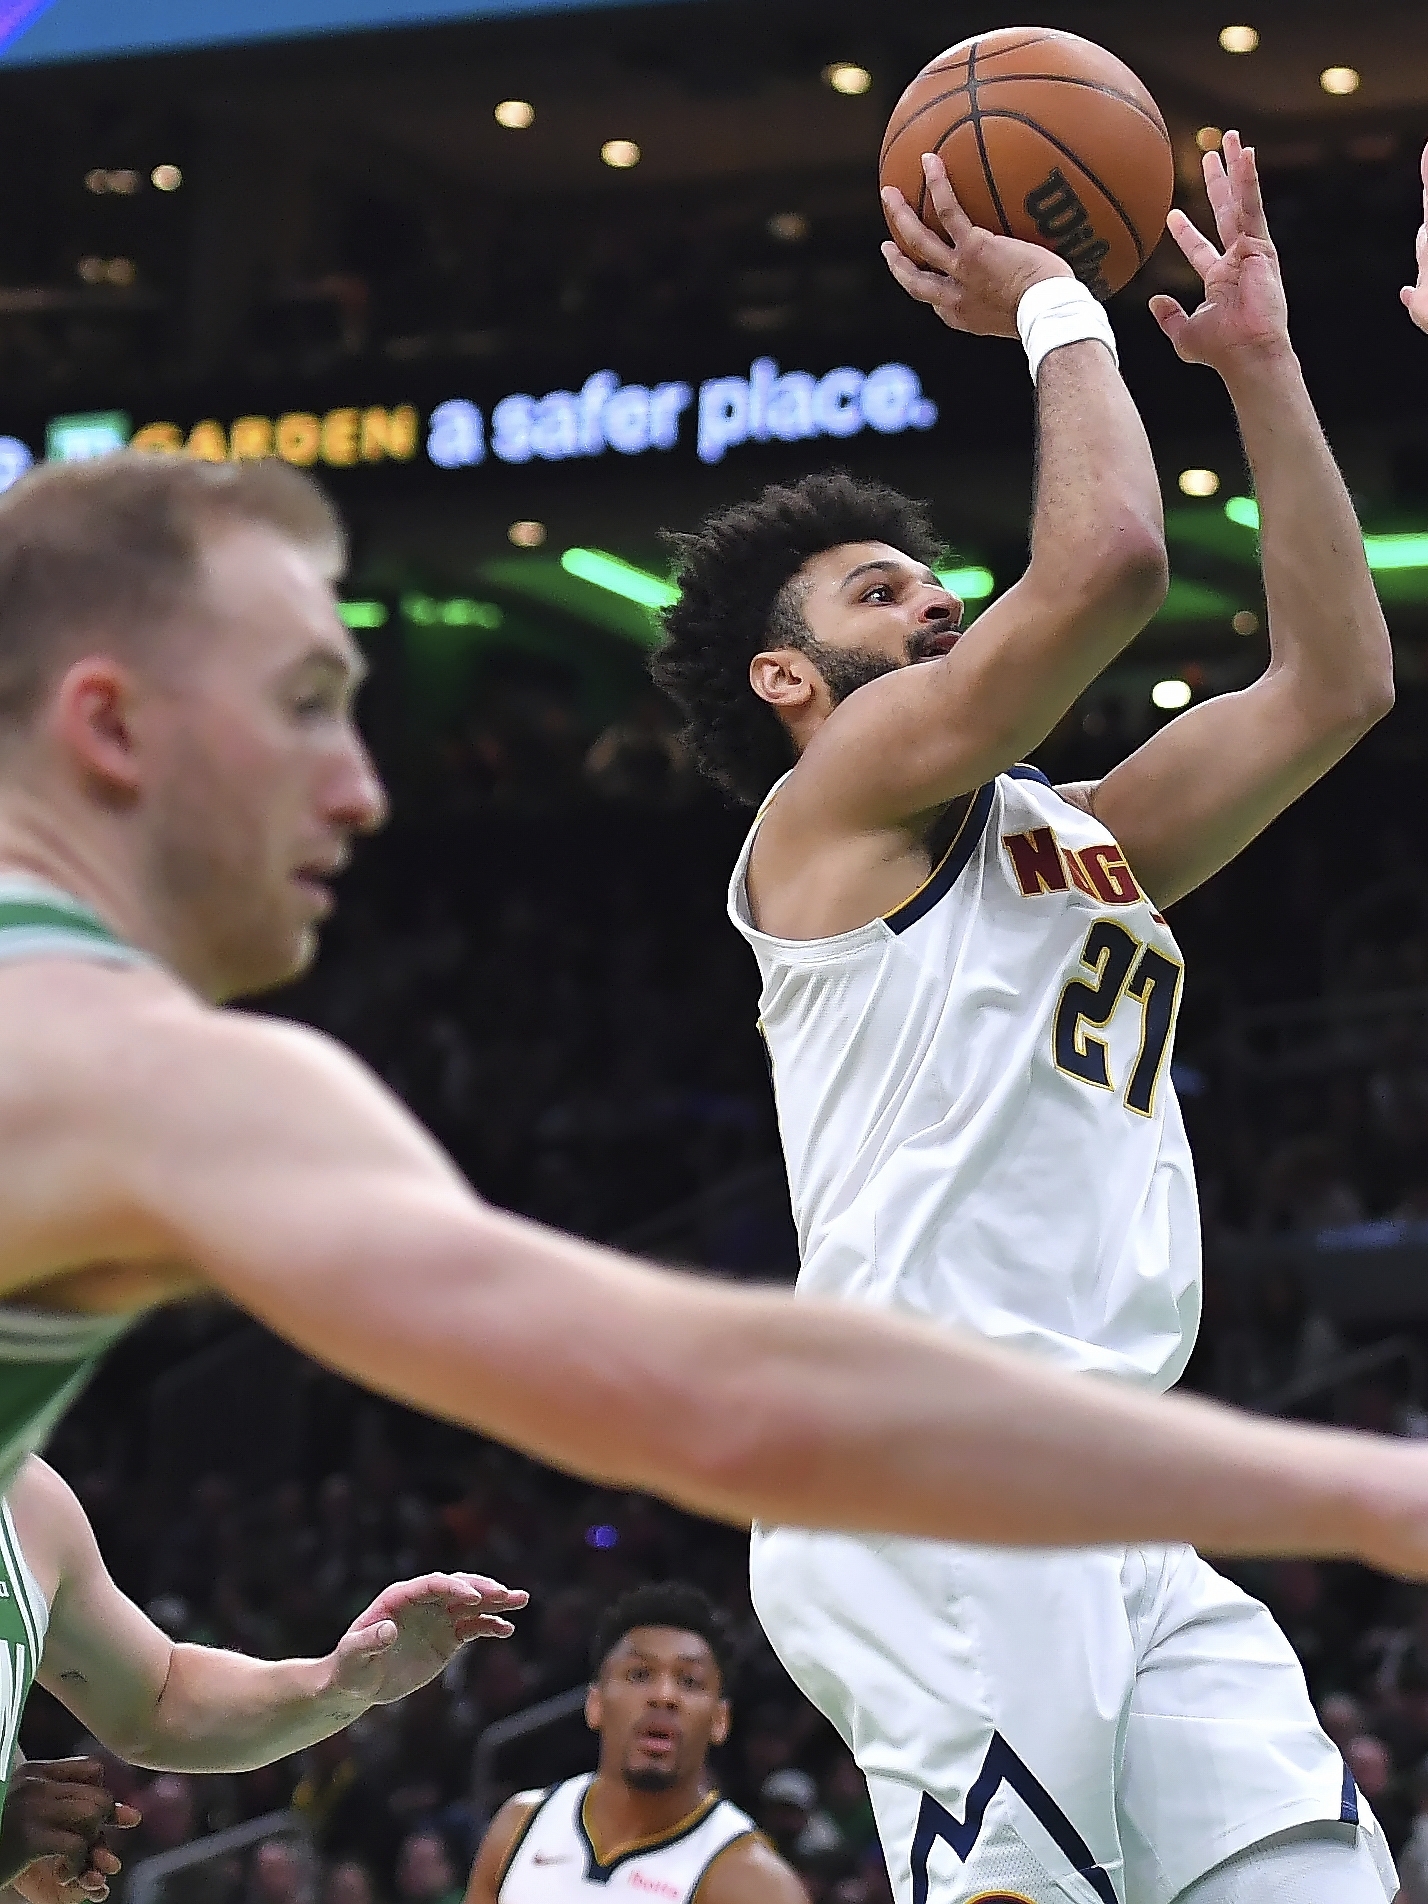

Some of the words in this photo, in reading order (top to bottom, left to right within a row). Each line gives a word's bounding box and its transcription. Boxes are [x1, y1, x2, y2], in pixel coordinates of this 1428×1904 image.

[427, 399, 485, 469] a
[491, 369, 692, 464] safer
[698, 356, 937, 464] place.
[1051, 917, 1185, 1119] 27
